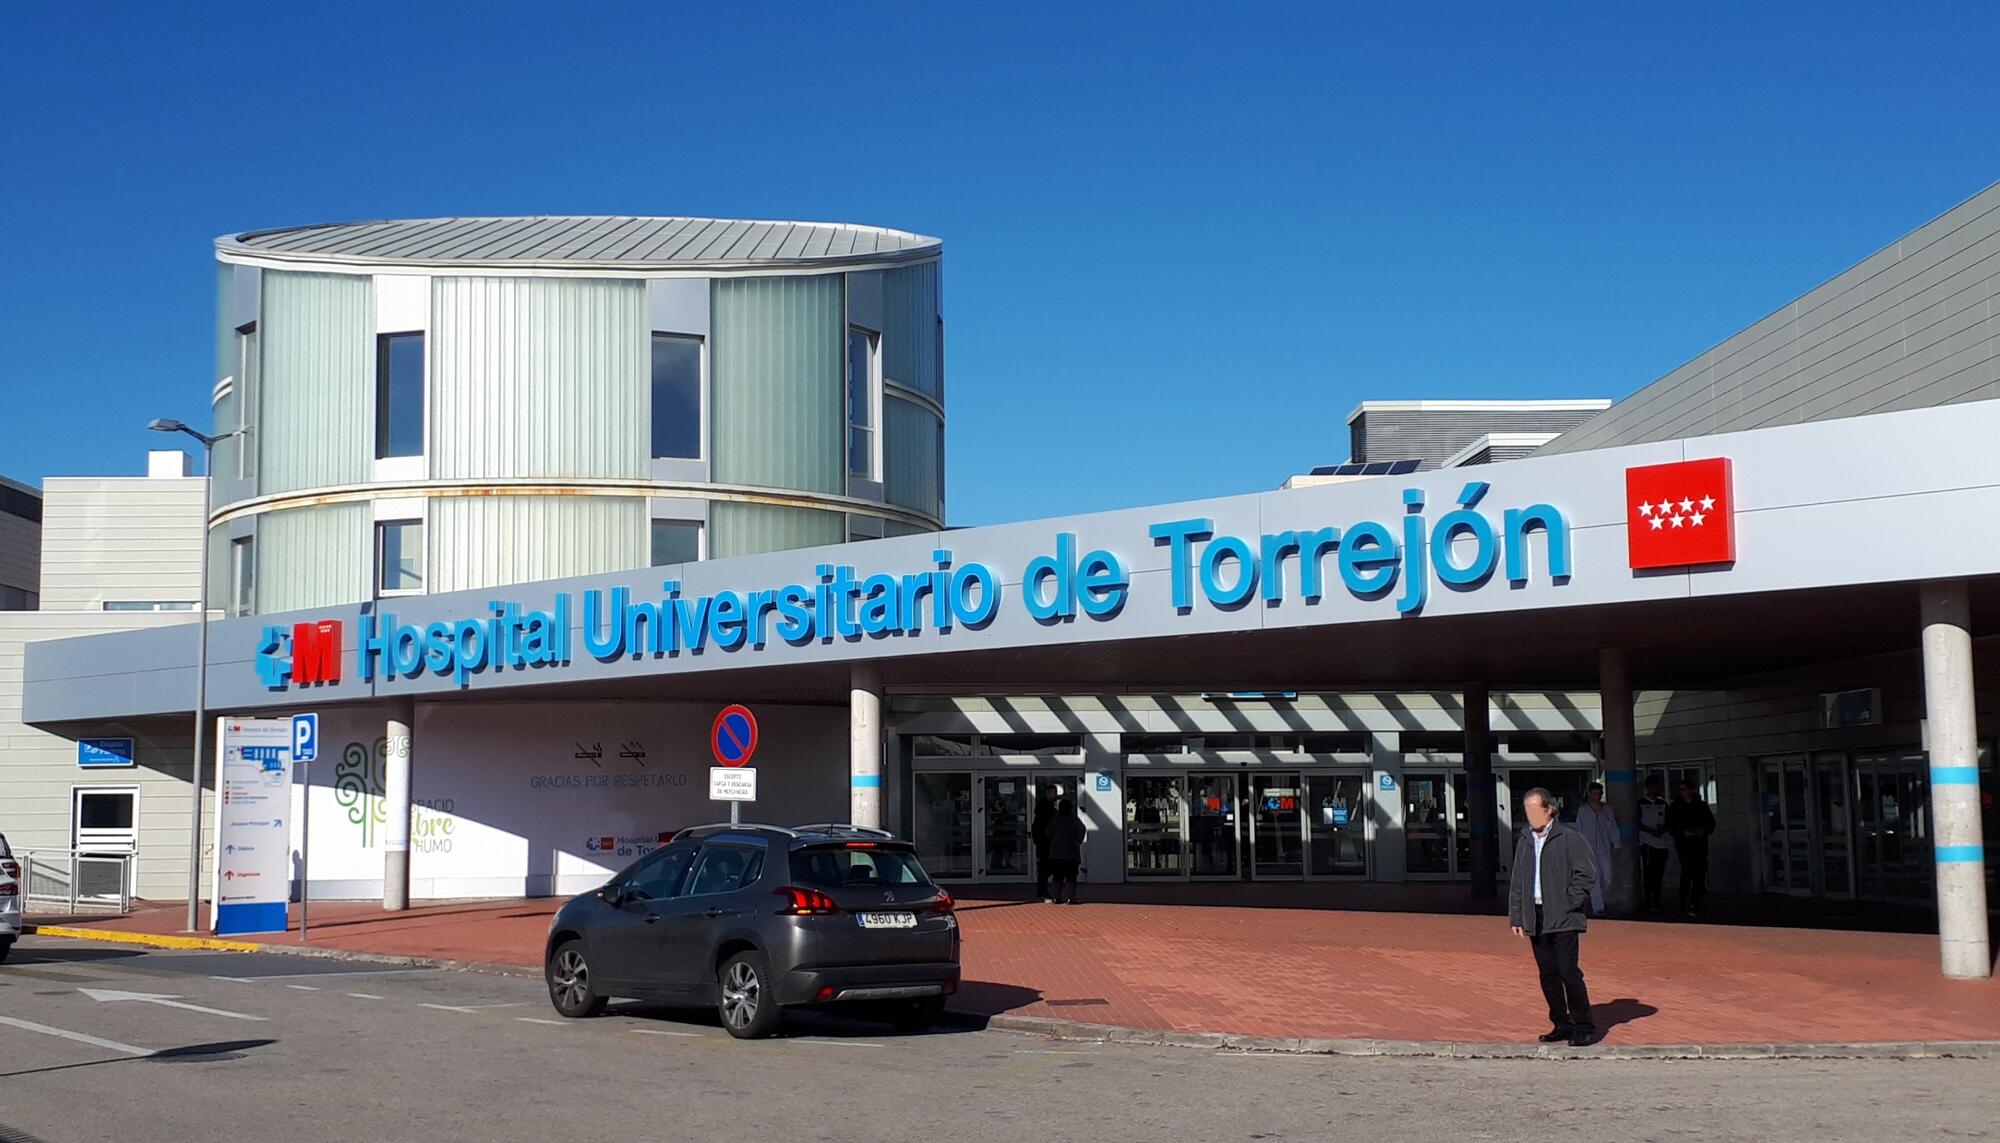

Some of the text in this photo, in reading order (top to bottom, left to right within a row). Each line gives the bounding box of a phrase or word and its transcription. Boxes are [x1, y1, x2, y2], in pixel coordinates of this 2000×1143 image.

[358, 591, 573, 687] Hospital
[583, 548, 1002, 660] Universitario
[1022, 532, 1130, 620] de
[1149, 481, 1572, 615] Torrejón
[296, 720, 311, 756] P
[530, 774, 687, 789] GRACIAS POR RESPETARLO
[416, 838, 452, 854] HUMO
[617, 835, 653, 844] Hospital
[617, 845, 633, 856] de
[865, 913, 892, 924] 4960
